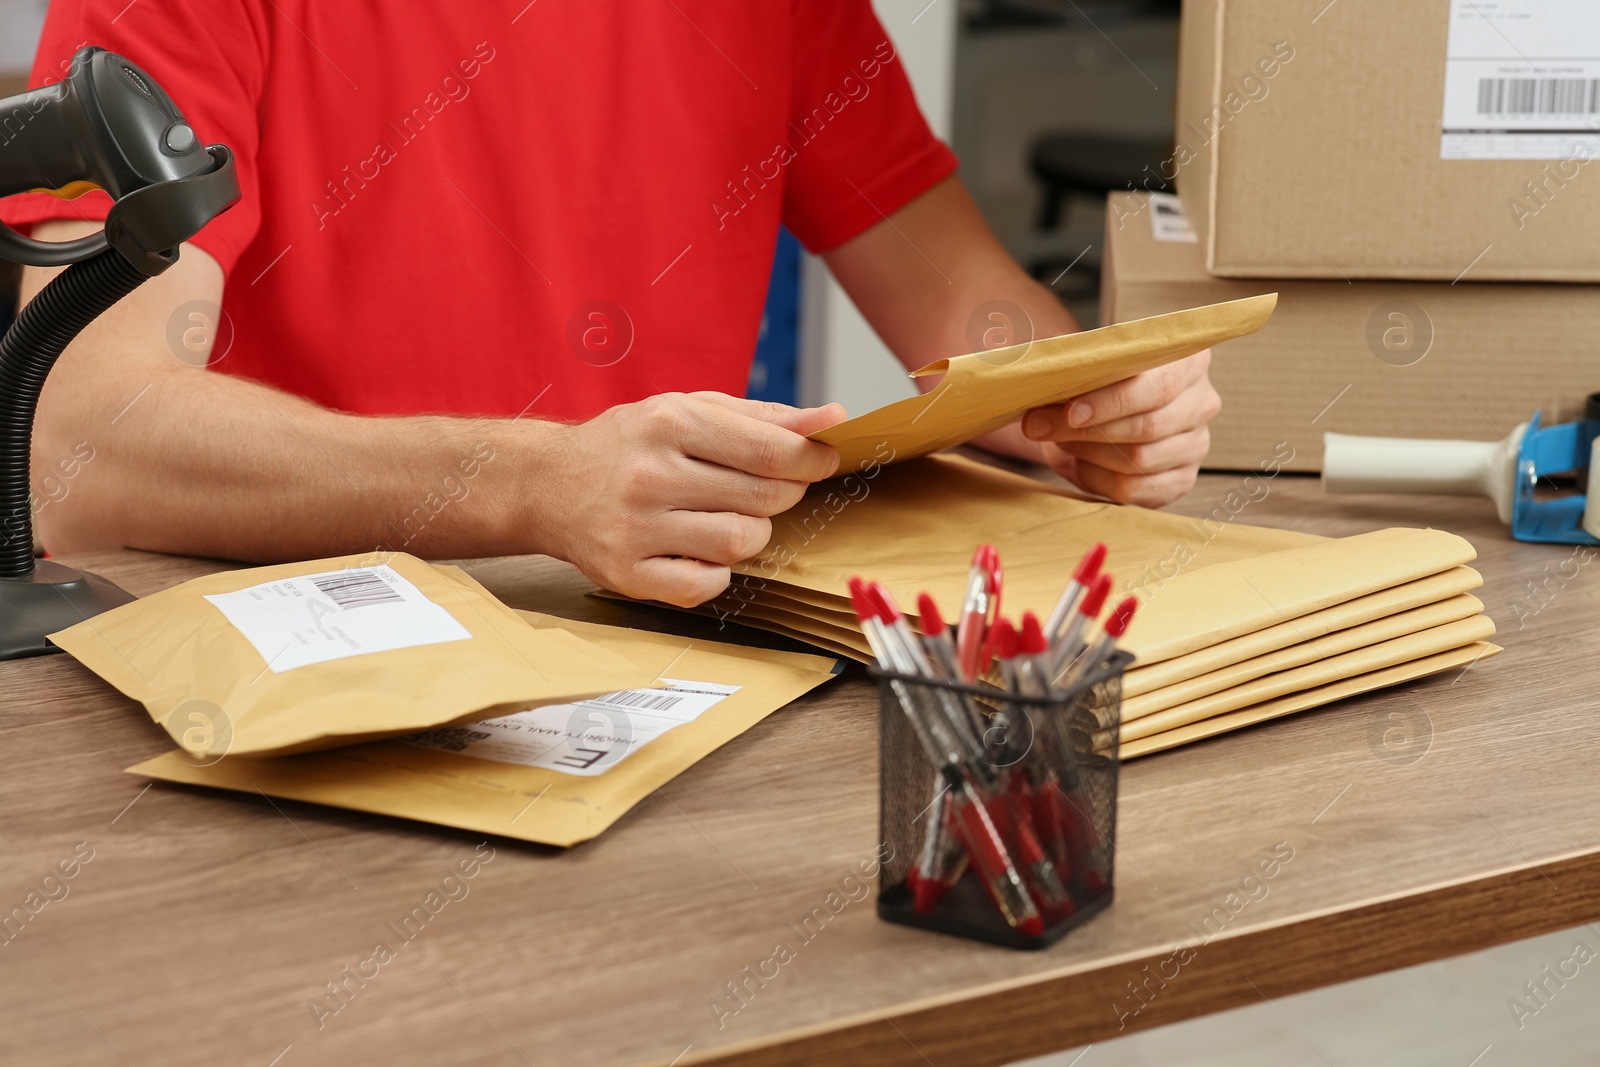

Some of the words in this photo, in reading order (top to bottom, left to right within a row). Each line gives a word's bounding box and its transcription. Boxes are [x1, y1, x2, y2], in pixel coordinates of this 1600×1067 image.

[526, 726, 561, 736] MAIL
[563, 731, 638, 744] PRIORITY
[552, 748, 610, 769] E
